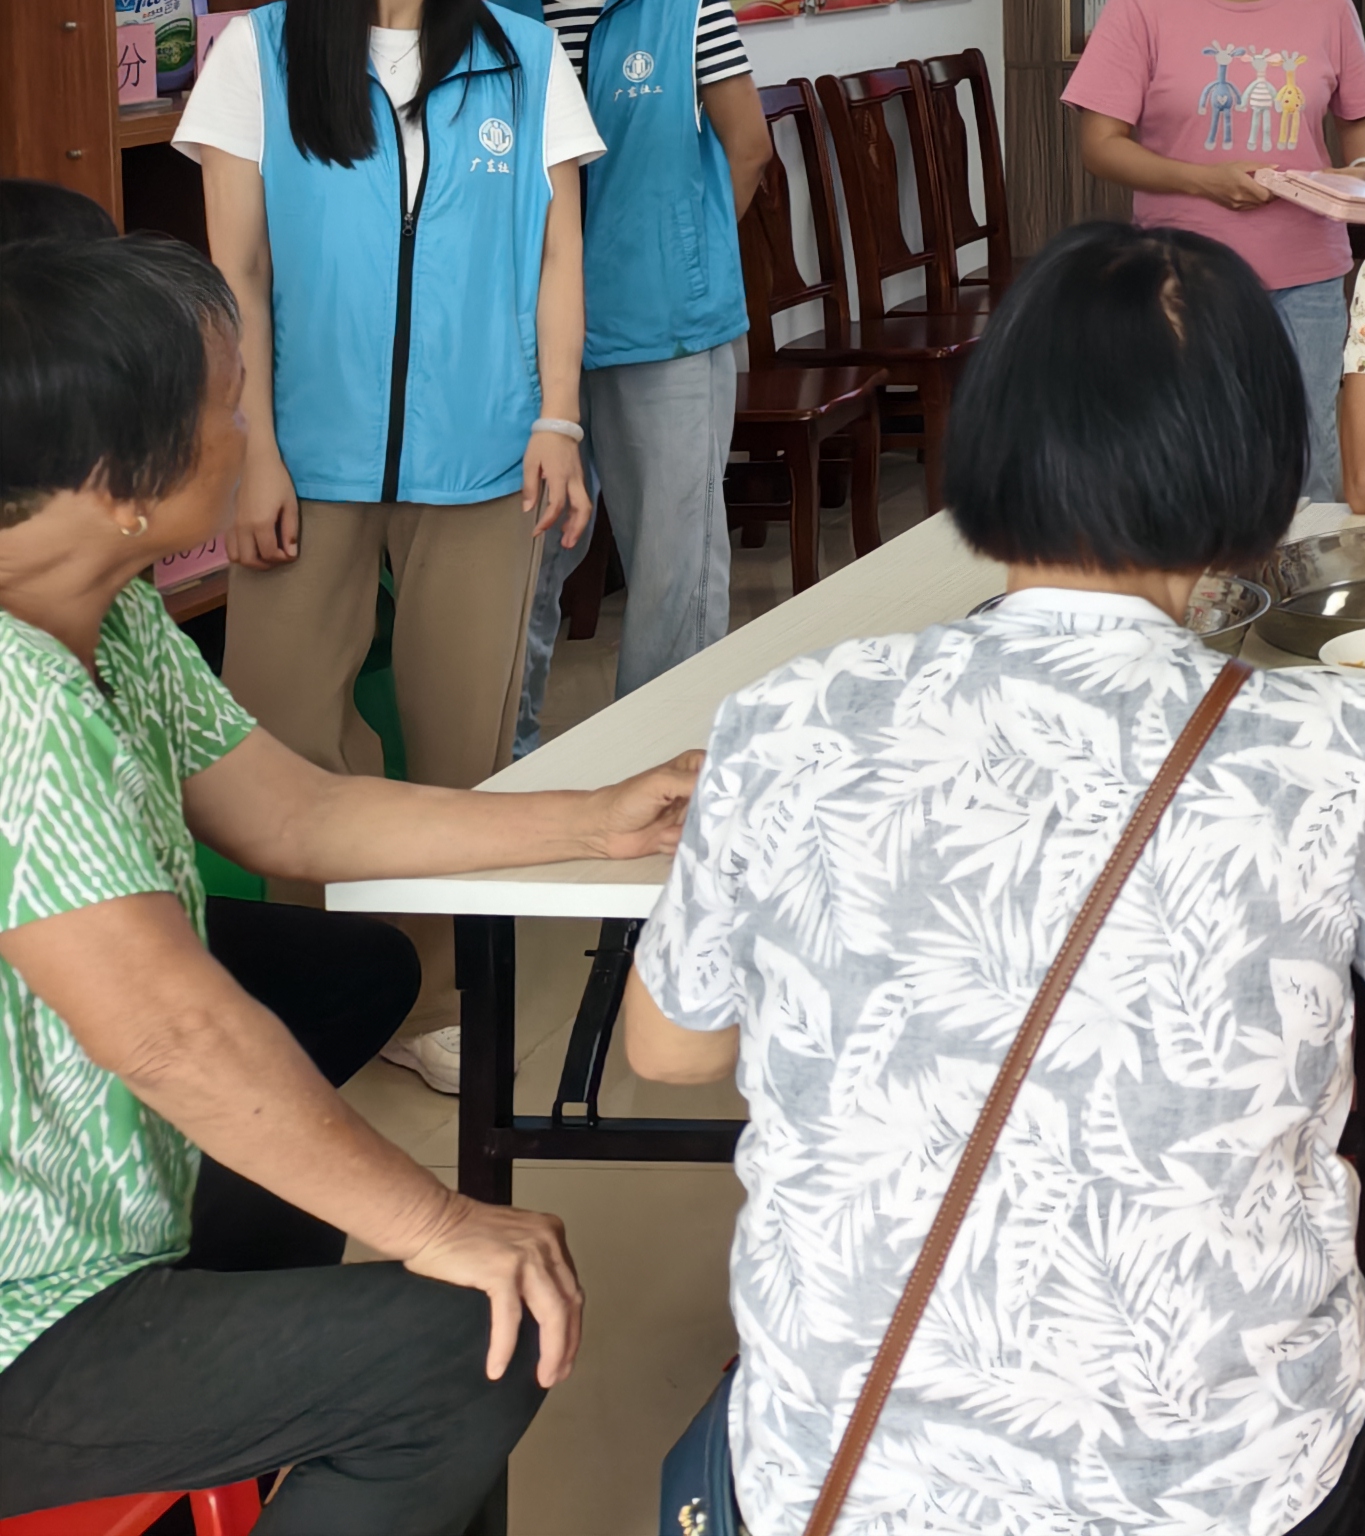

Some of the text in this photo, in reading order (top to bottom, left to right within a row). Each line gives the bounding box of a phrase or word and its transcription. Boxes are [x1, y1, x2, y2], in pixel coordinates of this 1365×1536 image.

[118, 42, 147, 89] 分
[469, 156, 511, 174] 广东社
